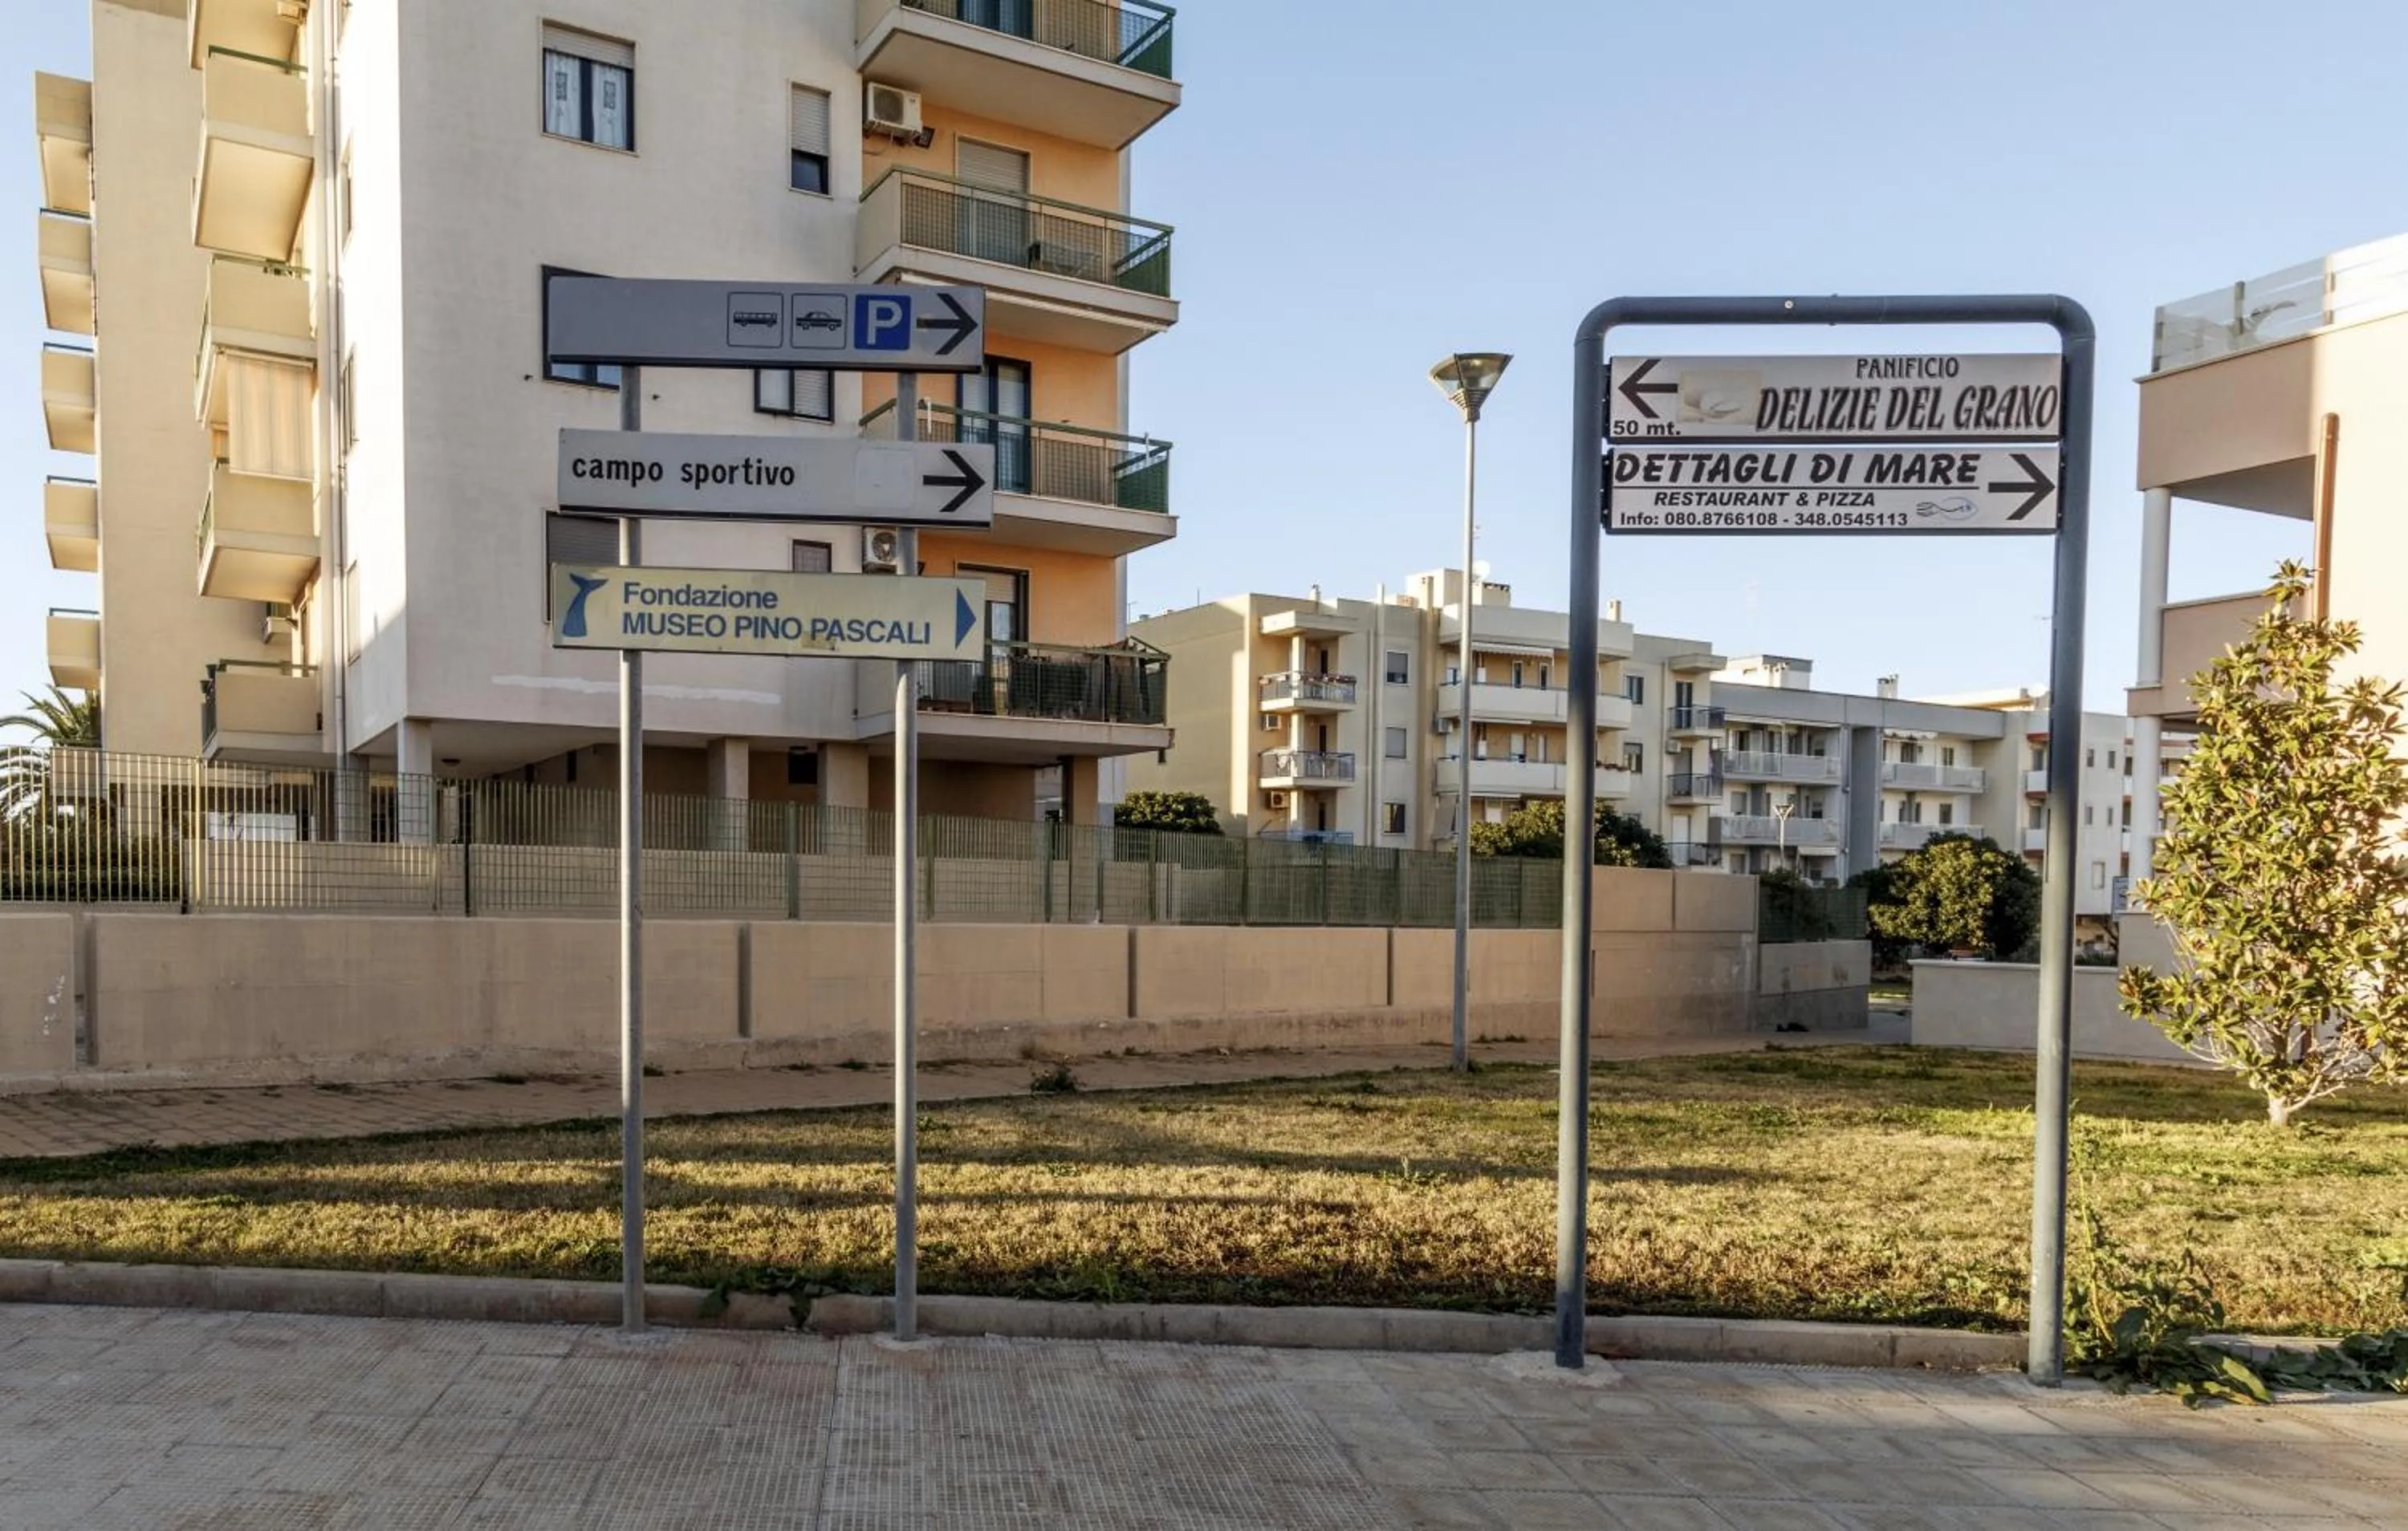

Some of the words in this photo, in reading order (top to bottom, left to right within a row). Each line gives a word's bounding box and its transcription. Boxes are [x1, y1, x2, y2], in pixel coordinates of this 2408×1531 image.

[1857, 356, 1959, 379] PANIFICIO
[1755, 385, 1881, 431] DELIZIE
[1885, 385, 1946, 431] DEL
[1953, 384, 2059, 430] GRANO
[1613, 420, 1639, 436] 50
[1646, 421, 1682, 436] mt.
[571, 457, 664, 488] campo
[681, 457, 795, 490] sportivo
[1614, 453, 1798, 484] DETTAGLI
[1809, 453, 1854, 484] DI
[1863, 453, 1981, 485] MARE
[1653, 492, 1791, 506] RESTAURANT
[1796, 492, 1809, 507] &
[1816, 492, 1876, 506] PIZZA
[1620, 512, 1659, 526] Info:
[1664, 512, 1778, 526] 080.8766108
[1795, 512, 1908, 526] 348.0545113
[623, 582, 779, 609] Fondazione
[622, 612, 726, 638] MUSEO
[735, 617, 803, 641] PINO
[811, 619, 931, 645] PASCALI
